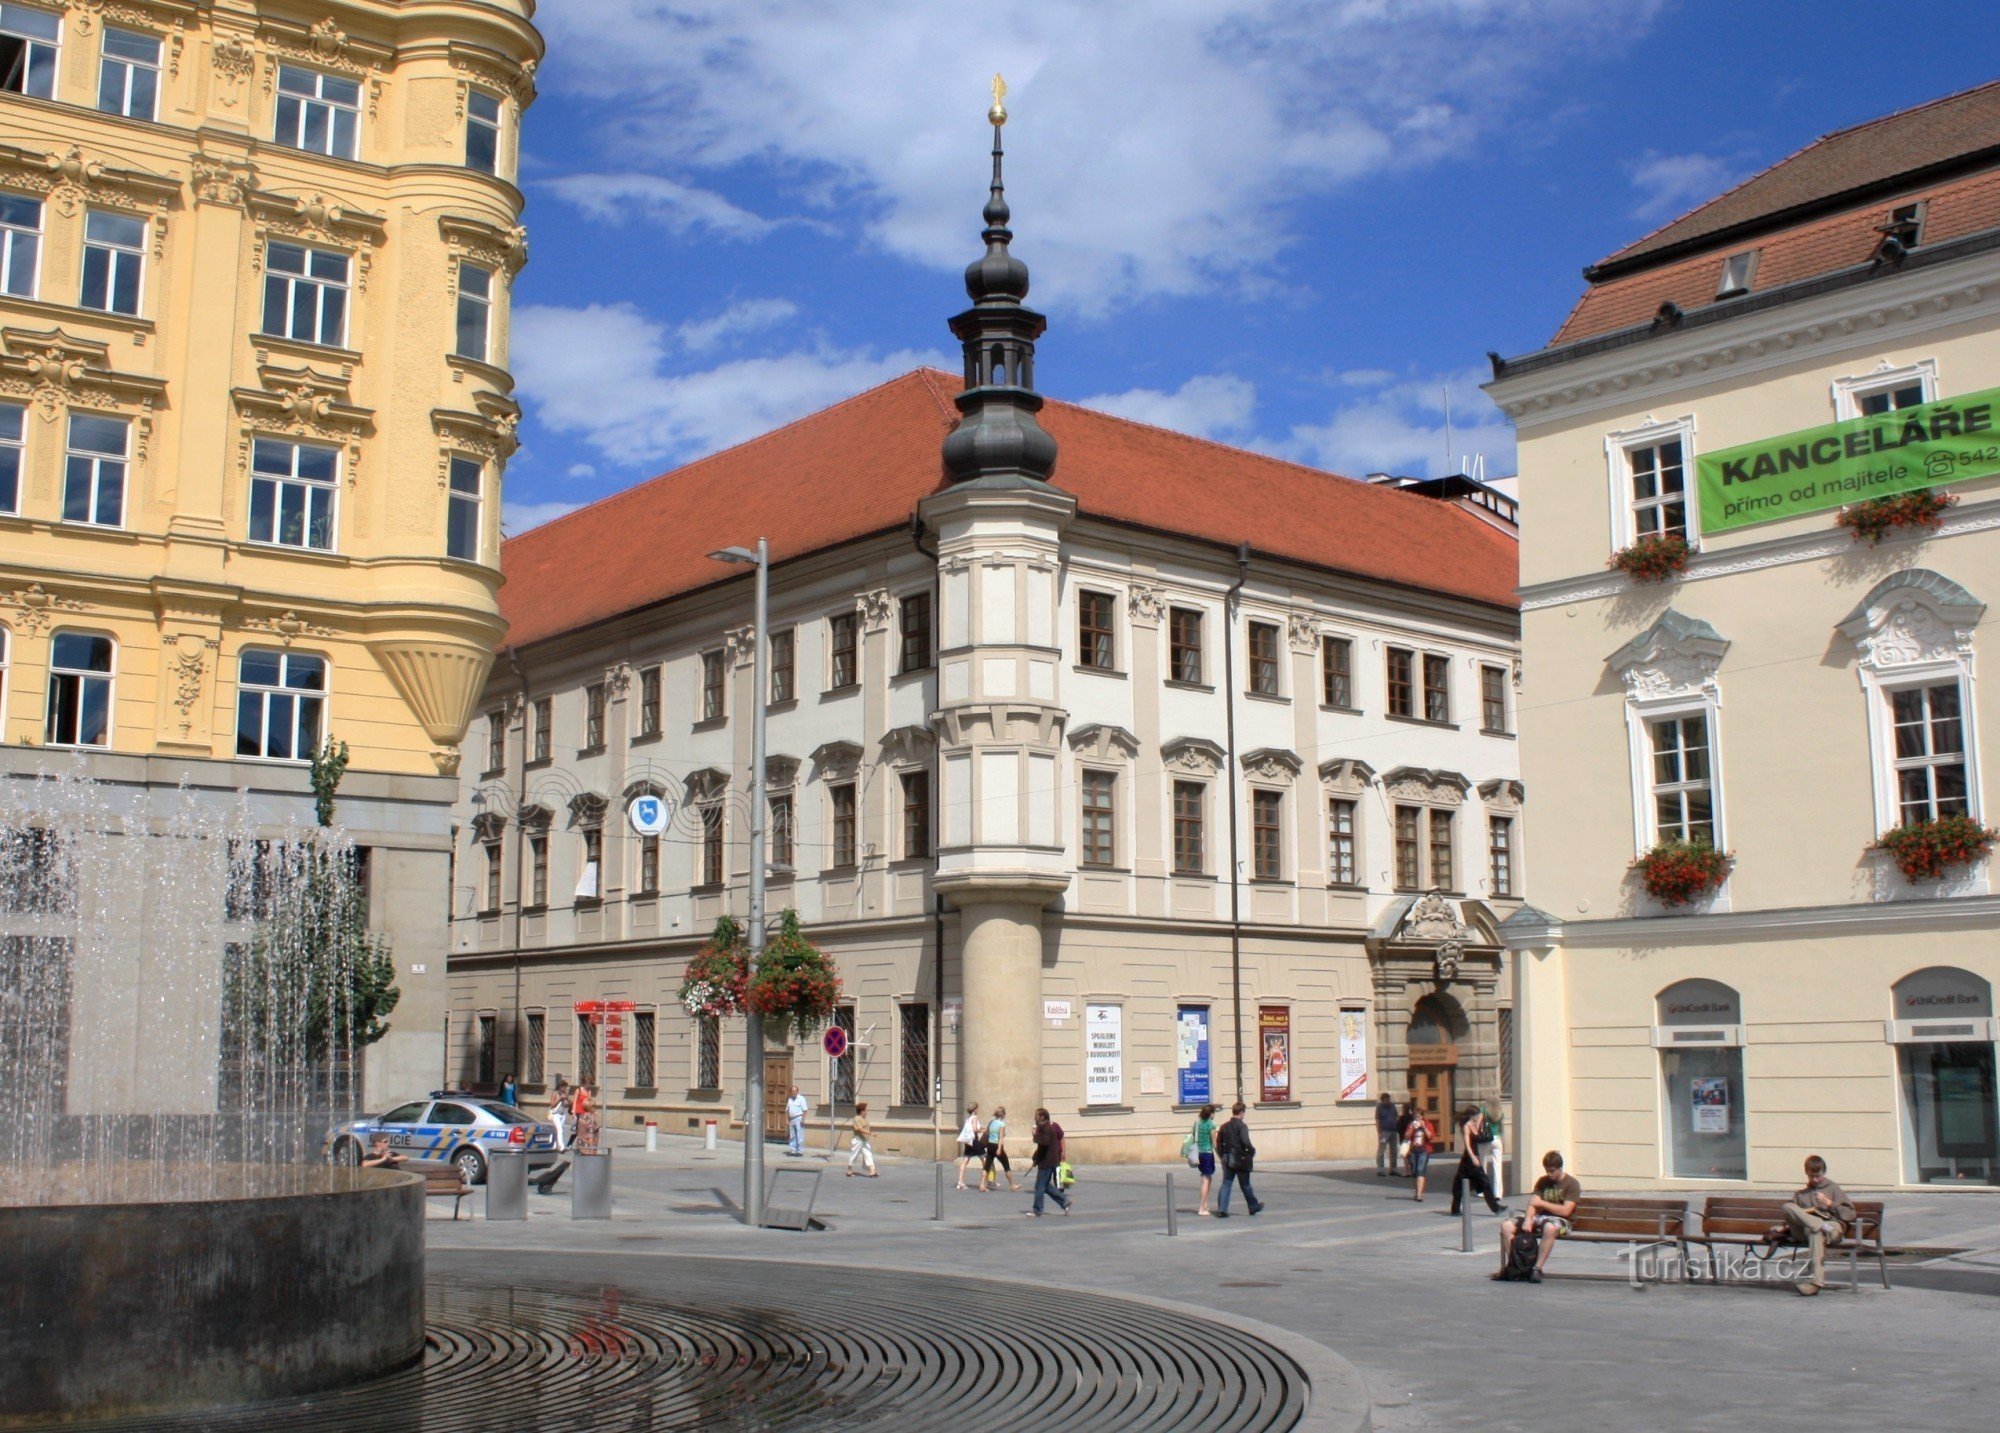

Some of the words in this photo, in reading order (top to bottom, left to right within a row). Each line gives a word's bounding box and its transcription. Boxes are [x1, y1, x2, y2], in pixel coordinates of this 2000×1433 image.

[1721, 403, 1992, 487] KANCELÁŘE
[1723, 493, 1784, 520] přímo
[1790, 482, 1817, 502] od
[1822, 465, 1908, 495] majitele
[1958, 446, 1998, 467] 542
[1956, 993, 1980, 1004] Bank
